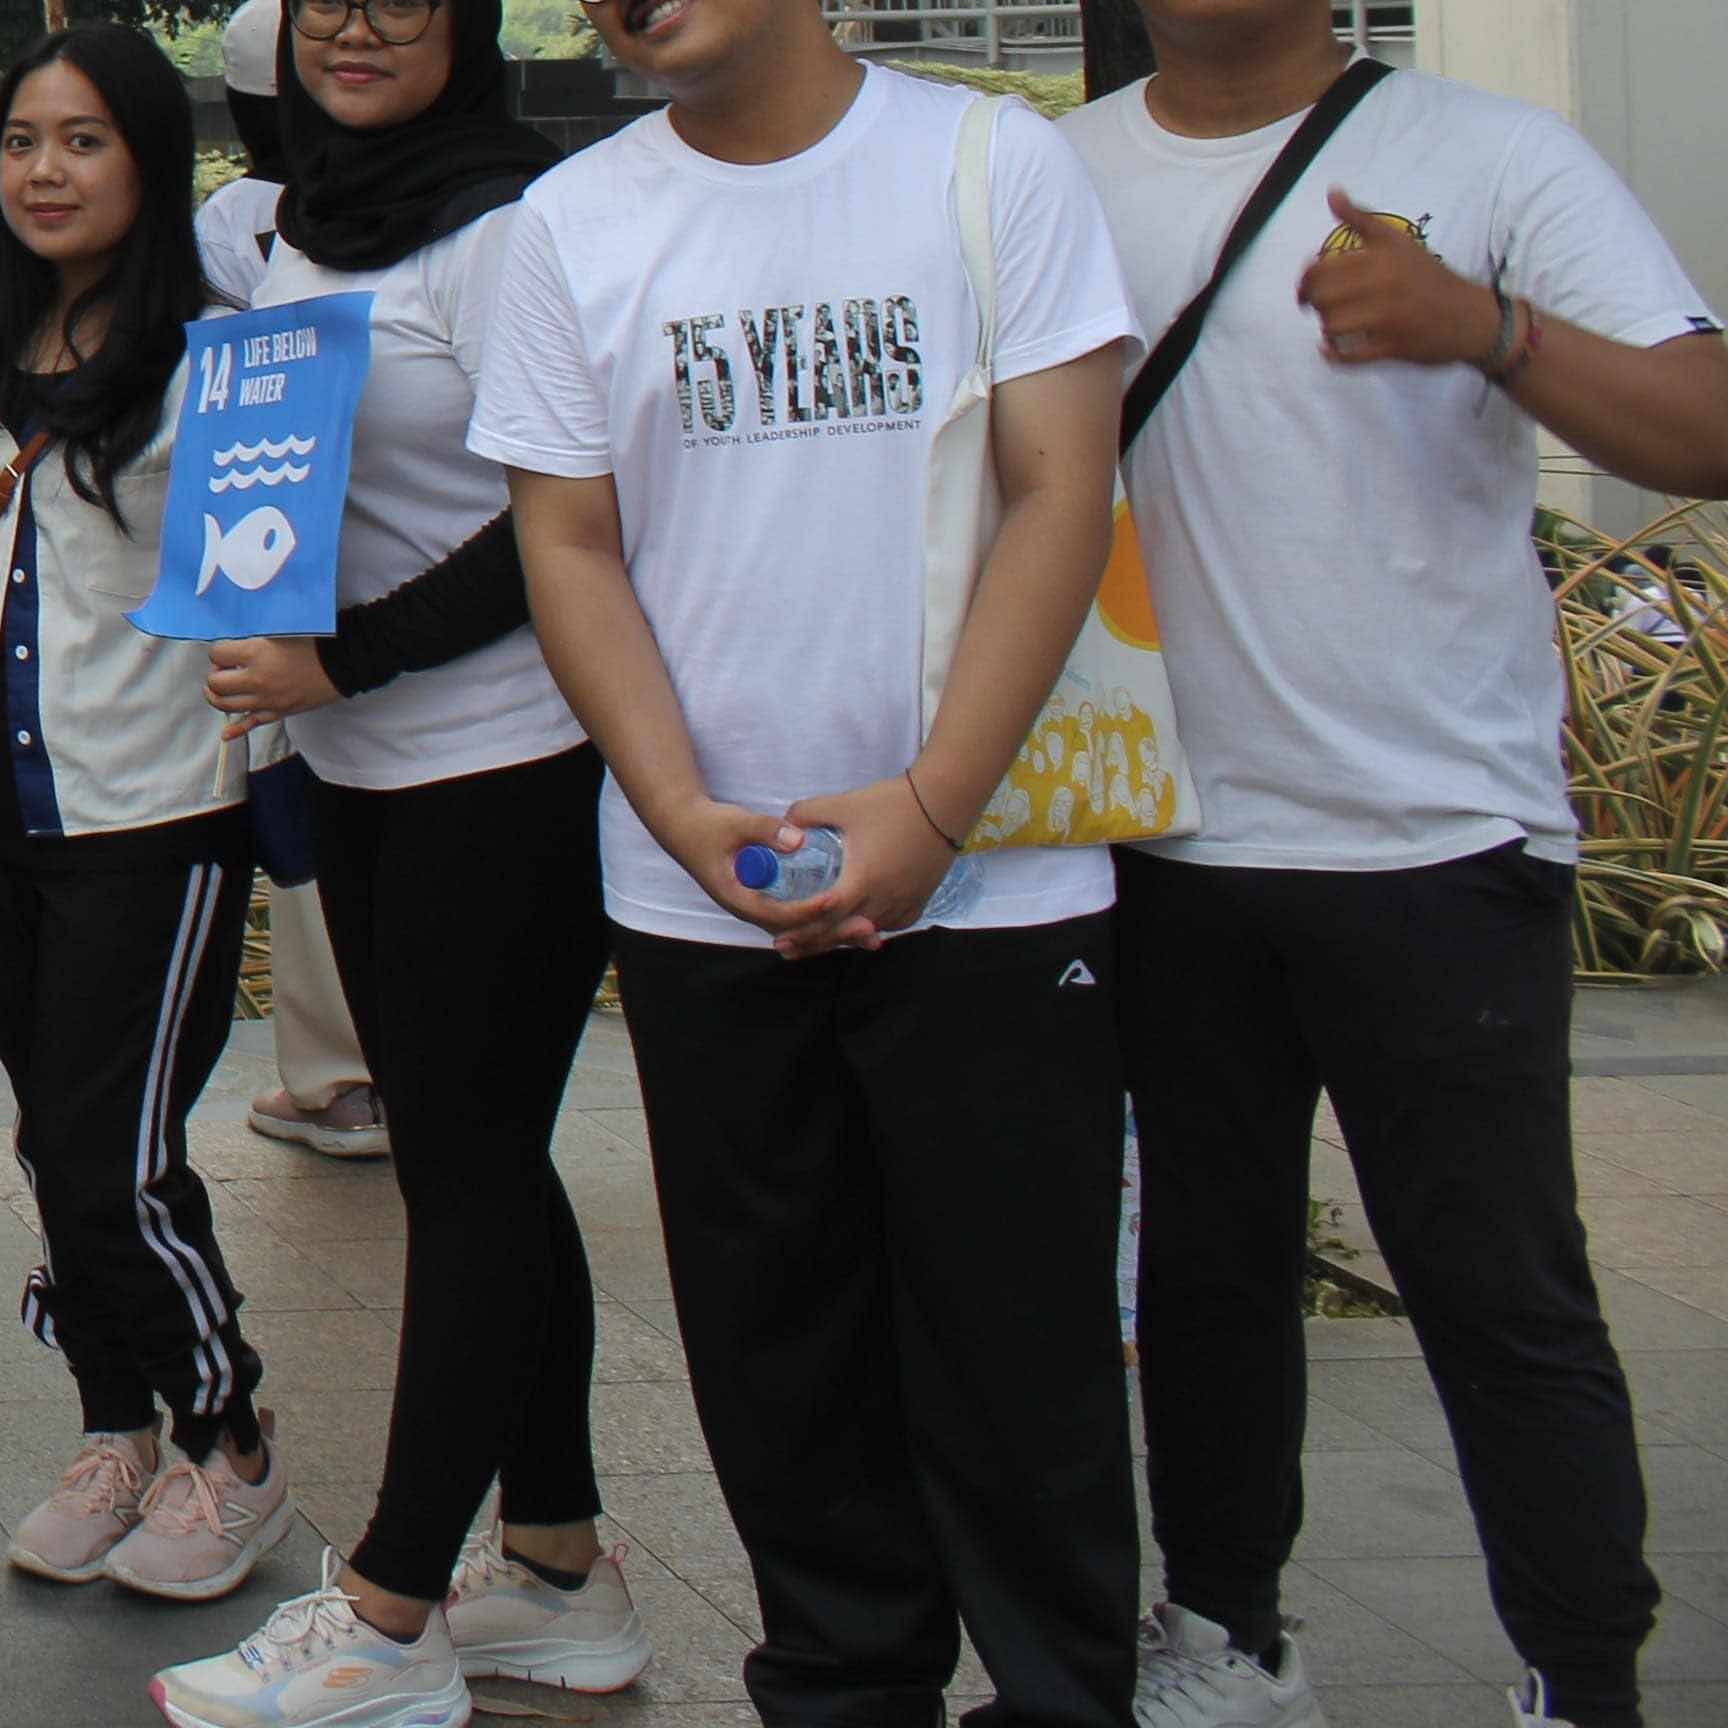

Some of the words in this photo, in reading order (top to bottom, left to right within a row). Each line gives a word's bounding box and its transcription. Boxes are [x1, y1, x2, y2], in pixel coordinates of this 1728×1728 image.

[243, 336, 271, 369] LIFE
[273, 326, 318, 364] BELOW
[738, 294, 923, 427] YEARS
[197, 343, 233, 414] 14
[239, 372, 286, 407] WATER
[747, 427, 821, 445] LEADERSHIP
[827, 420, 922, 437] DEVELOPMENT
